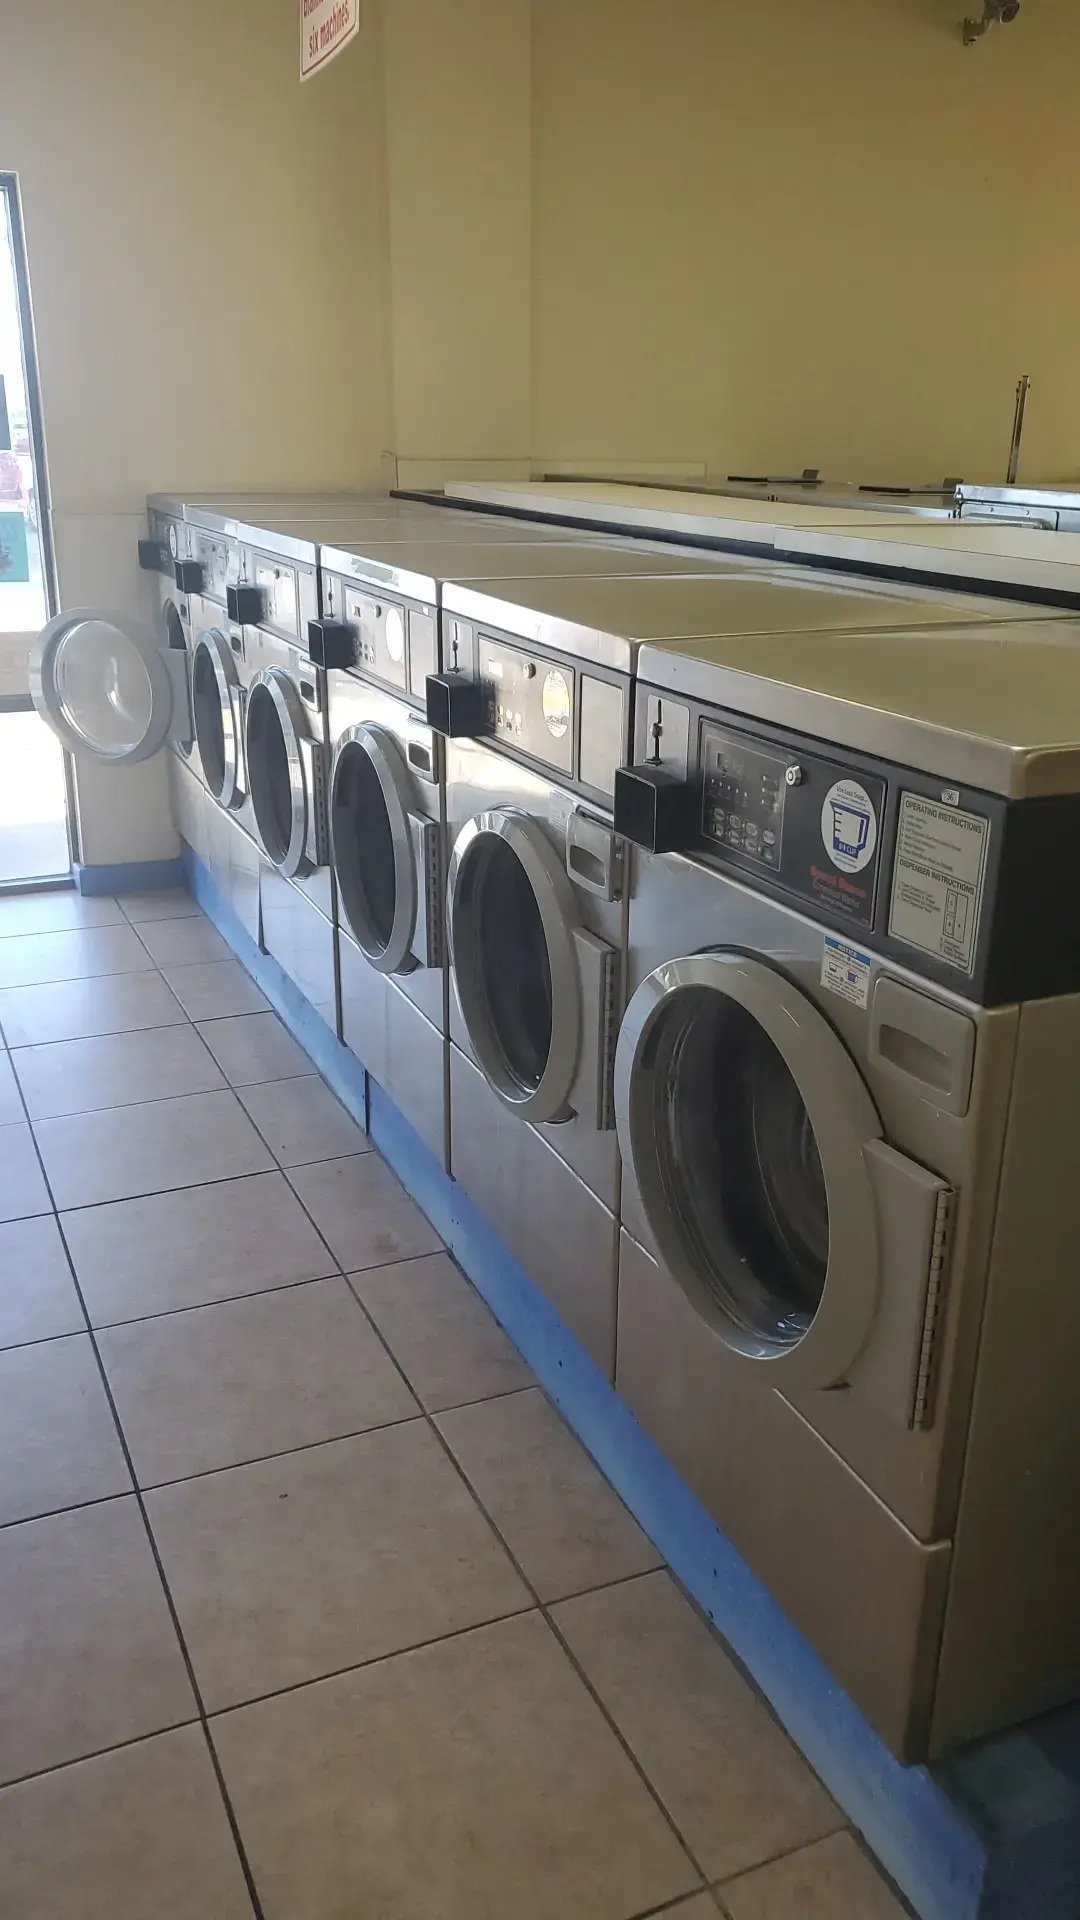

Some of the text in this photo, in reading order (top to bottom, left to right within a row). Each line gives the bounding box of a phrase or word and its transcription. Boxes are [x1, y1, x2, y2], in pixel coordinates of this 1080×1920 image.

[309, 25, 319, 58] six
[320, 0, 350, 50] machines
[905, 800, 937, 818] OPERATING
[938, 809, 982, 834] INSTRUCTIONS
[899, 858, 931, 878] DISPENSER
[931, 870, 975, 895] INSTRUCTIONS
